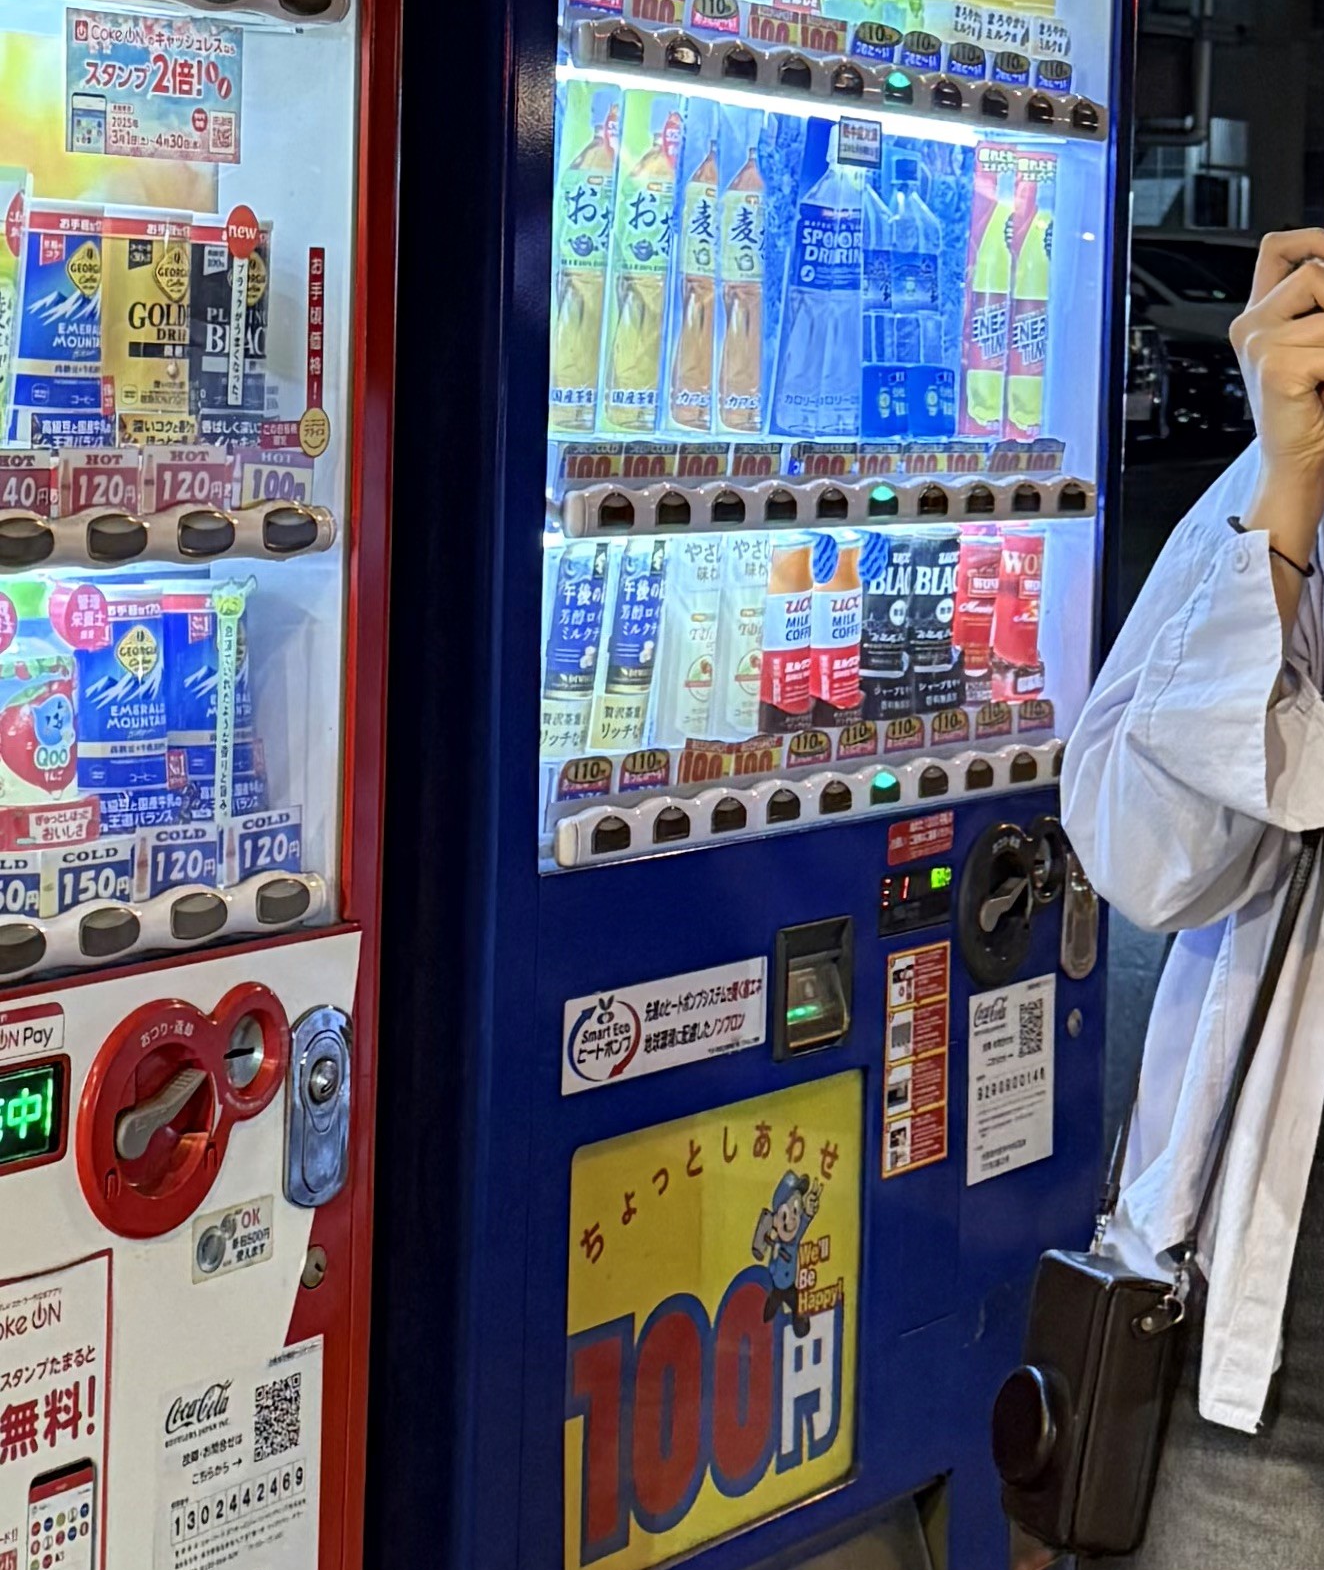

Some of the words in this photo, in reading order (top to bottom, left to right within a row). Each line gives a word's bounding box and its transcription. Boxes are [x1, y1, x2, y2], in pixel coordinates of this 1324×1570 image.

[85, 53, 203, 97] スタンプ2倍!
[228, 224, 258, 241] new
[690, 198, 716, 240] 麦
[58, 322, 101, 335] EMERA
[85, 453, 124, 467] HOT
[169, 449, 211, 464] HOT
[261, 451, 293, 465] HOT
[78, 471, 137, 504] 120円
[161, 469, 224, 502] 120円
[1001, 549, 1043, 576] WO
[868, 566, 912, 596] BLA
[785, 628, 812, 642] COFF
[36, 746, 69, 768] Qoo
[42, 823, 85, 842] おいしさ
[155, 828, 207, 843] COLD
[242, 812, 291, 831] COLD
[62, 846, 119, 864] COLD
[243, 832, 300, 869] 120円
[155, 848, 216, 882] 120円
[62, 867, 130, 905] 150円
[22, 1026, 54, 1049] Pay
[581, 1027, 612, 1045] Smart
[613, 1021, 631, 1037] Eco
[576, 1035, 632, 1066] ヒートポンプ
[578, 1118, 841, 1266] ちょっとしあわせ
[240, 1207, 262, 1229] OK
[799, 1267, 817, 1291] Be
[797, 1277, 844, 1315] Happy!
[31, 1299, 62, 1330] ON
[0, 1344, 96, 1393] スタンプたまると
[0, 1374, 96, 1465] 無料!
[564, 1265, 844, 1567] 100円
[173, 1465, 305, 1537] 1302442469
